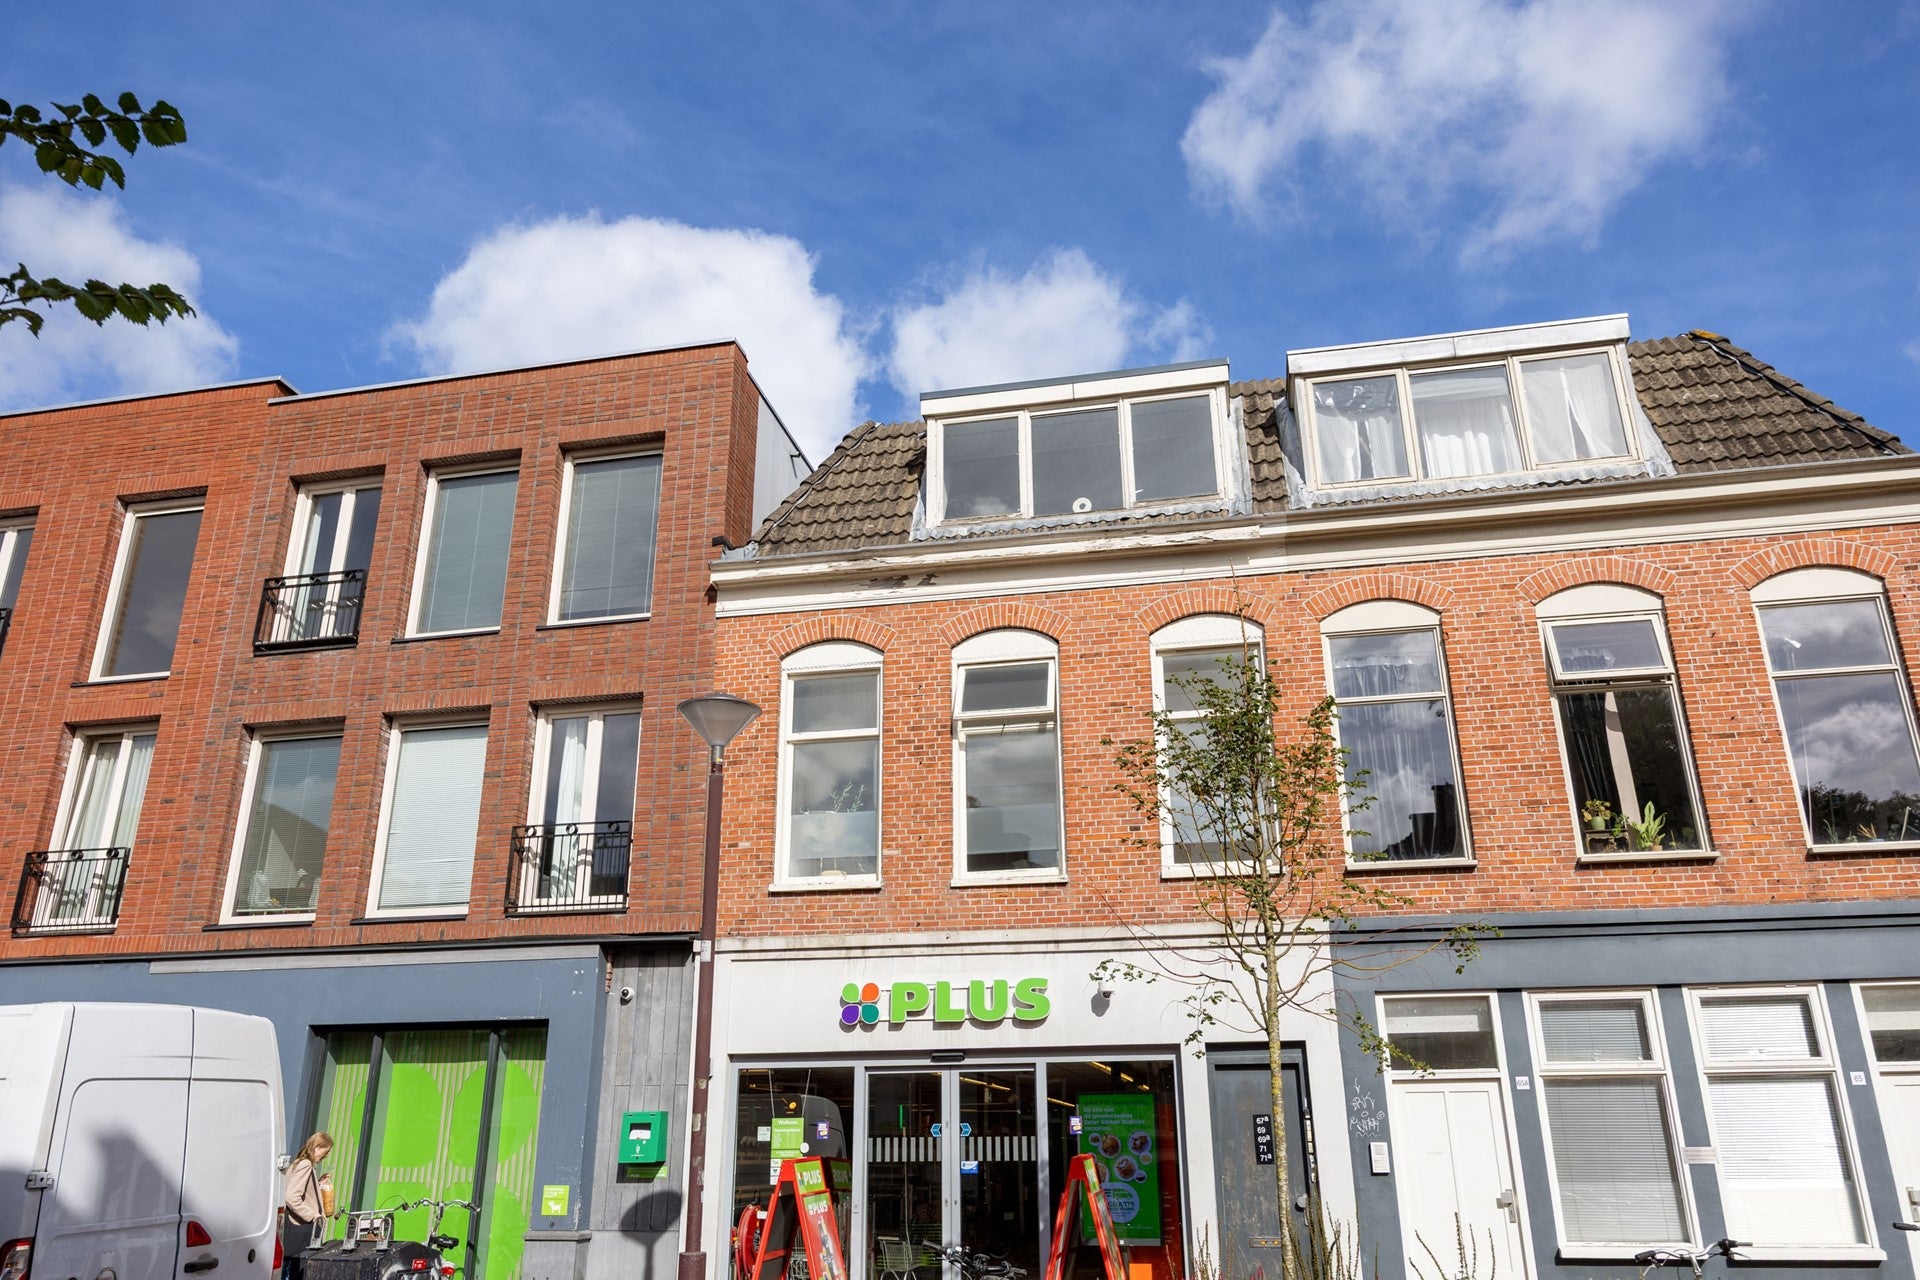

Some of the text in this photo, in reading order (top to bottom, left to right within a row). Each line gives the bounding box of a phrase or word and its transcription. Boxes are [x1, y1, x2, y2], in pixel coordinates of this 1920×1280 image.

[890, 977, 1051, 1023] PLUS
[1516, 1079, 1529, 1087] 65A
[1257, 1126, 1266, 1134] 69
[803, 1169, 822, 1186] PLUS
[813, 1200, 829, 1214] PLUS
